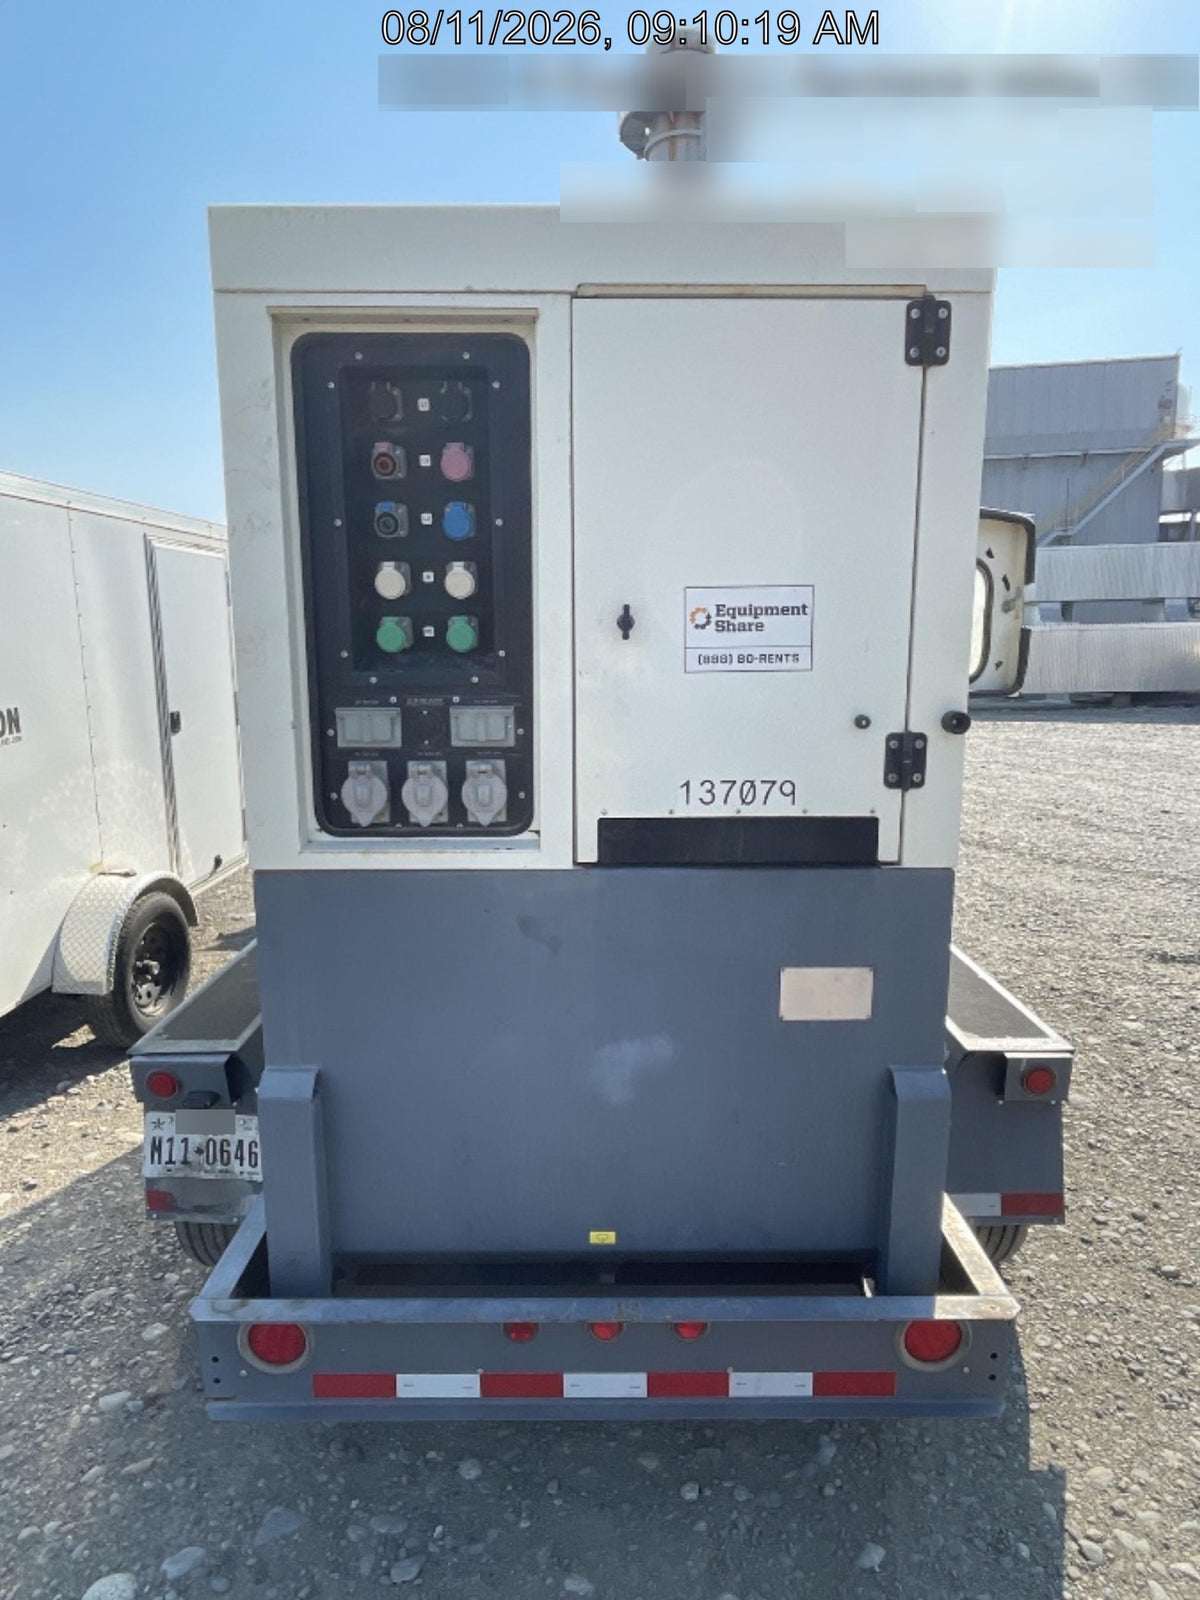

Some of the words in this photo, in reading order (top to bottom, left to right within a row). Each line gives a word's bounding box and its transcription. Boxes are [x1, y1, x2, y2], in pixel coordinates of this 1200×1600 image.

[714, 603, 808, 619] Equipment
[714, 619, 765, 632] Share
[698, 653, 733, 666] (888)
[737, 653, 799, 664] 80-RENTS
[679, 778, 797, 806] 137079
